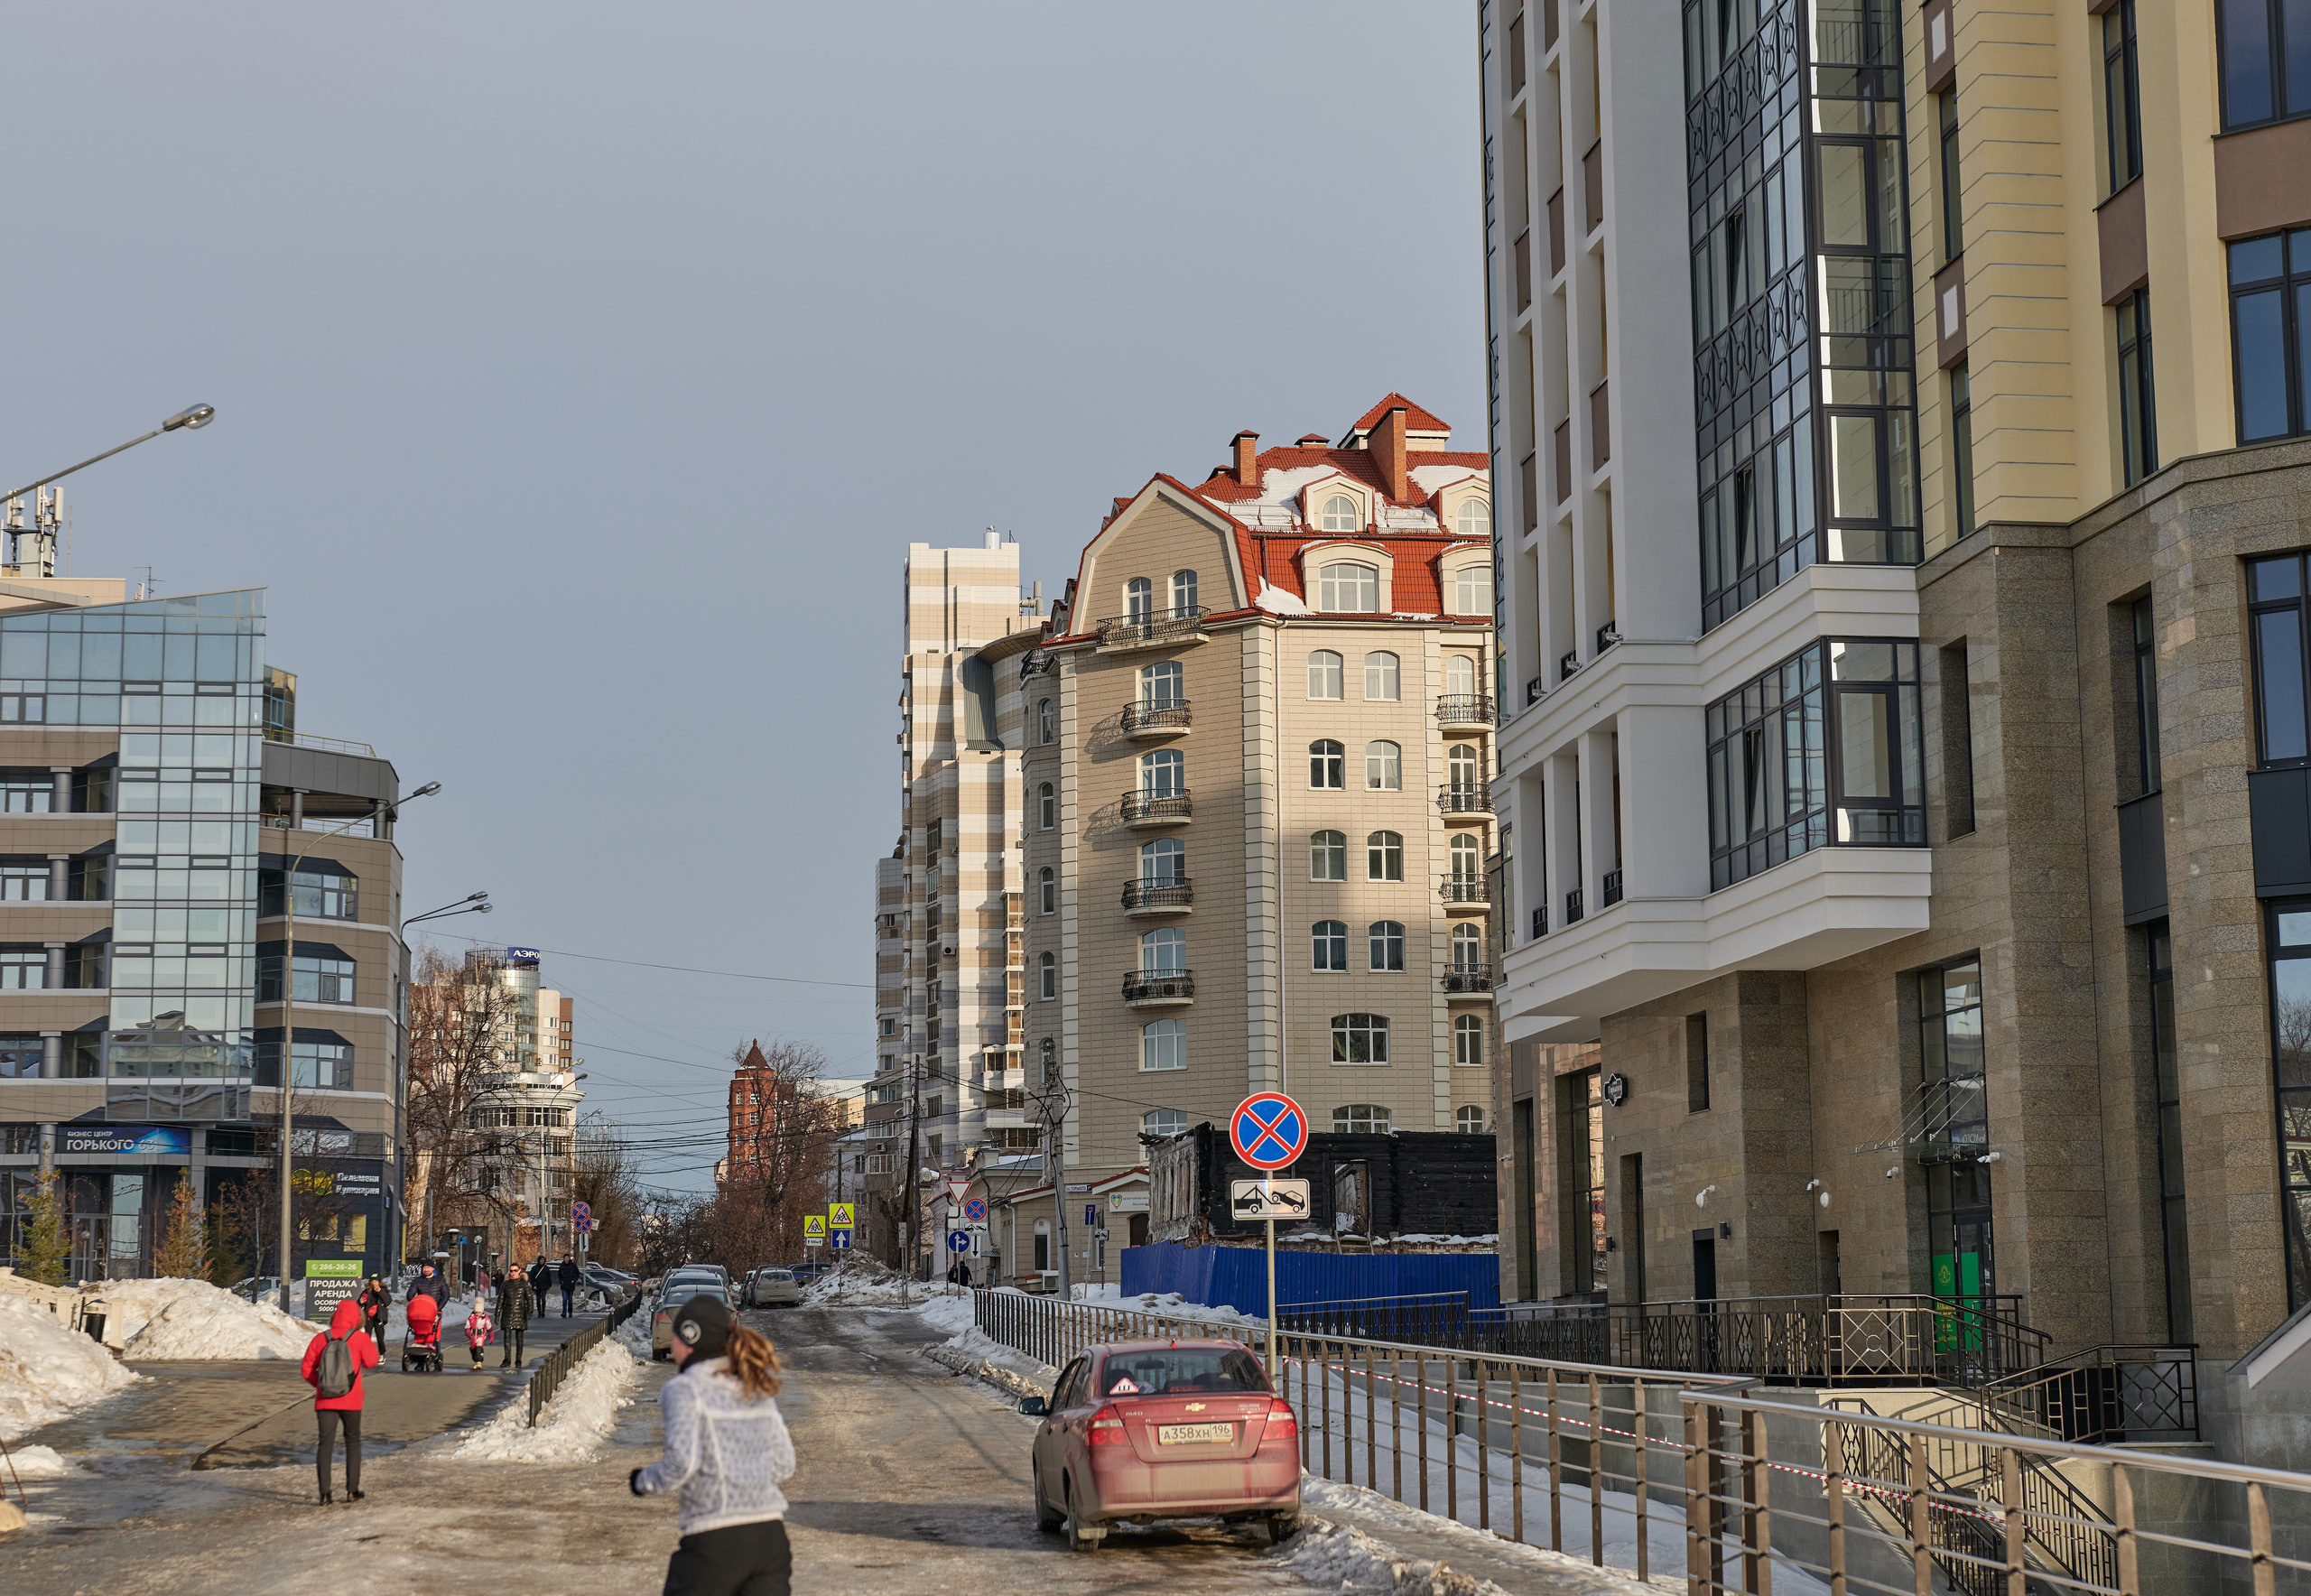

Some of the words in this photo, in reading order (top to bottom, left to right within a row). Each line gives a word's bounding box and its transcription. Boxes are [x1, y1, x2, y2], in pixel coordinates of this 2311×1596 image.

[513, 950, 541, 960] АЭРО
[66, 1139, 135, 1151] ГОРЬКОГО
[138, 1139, 155, 1150] 63
[337, 1173, 380, 1183] Пельмени
[310, 1280, 357, 1288] ПРОДАЖА
[314, 1290, 353, 1298] АРЕНДА
[1212, 1424, 1230, 1434] 196
